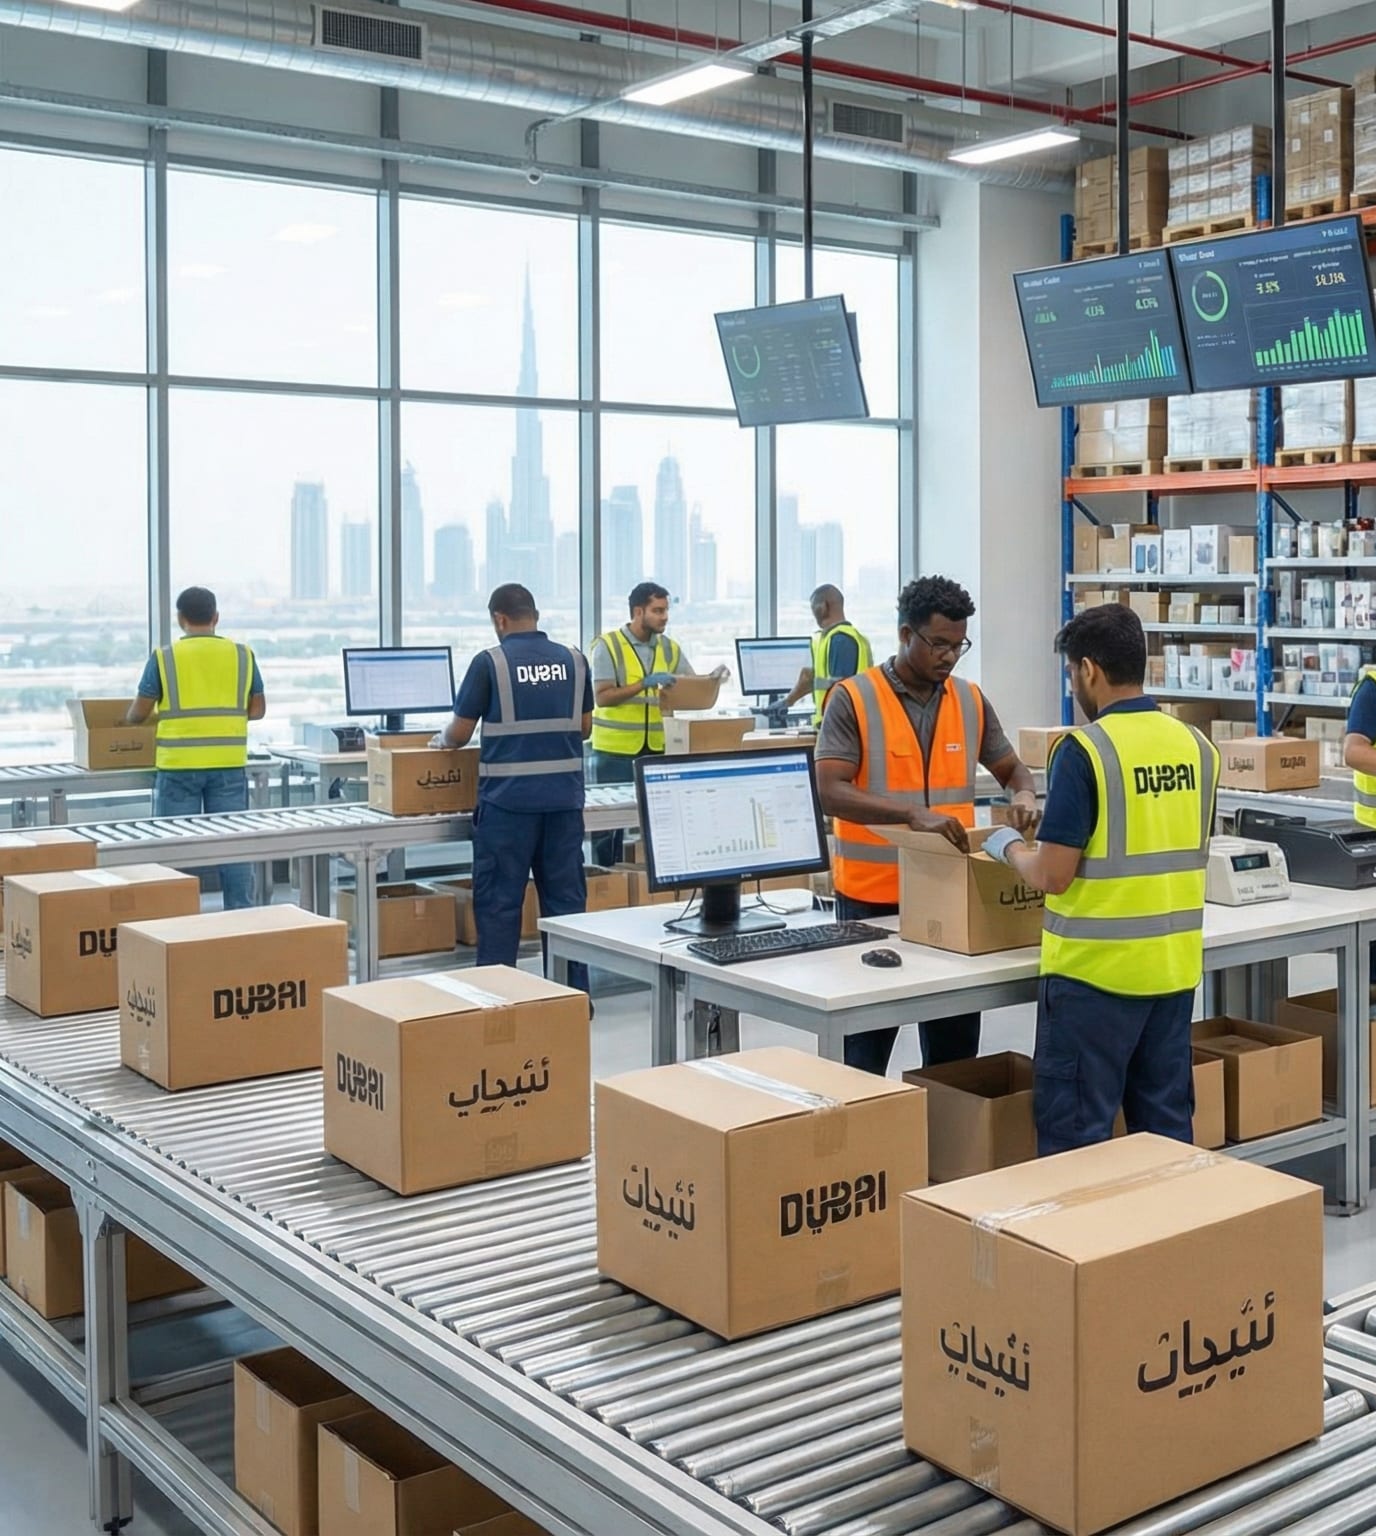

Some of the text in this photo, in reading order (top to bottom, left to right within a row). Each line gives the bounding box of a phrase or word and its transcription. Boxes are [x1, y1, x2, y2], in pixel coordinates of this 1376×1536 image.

[517, 663, 567, 685] DUBAI
[1134, 763, 1196, 798] DUBAI
[213, 979, 307, 1020] DUBAI
[336, 1052, 384, 1111] DUBAI
[780, 1170, 886, 1237] DUBAI
